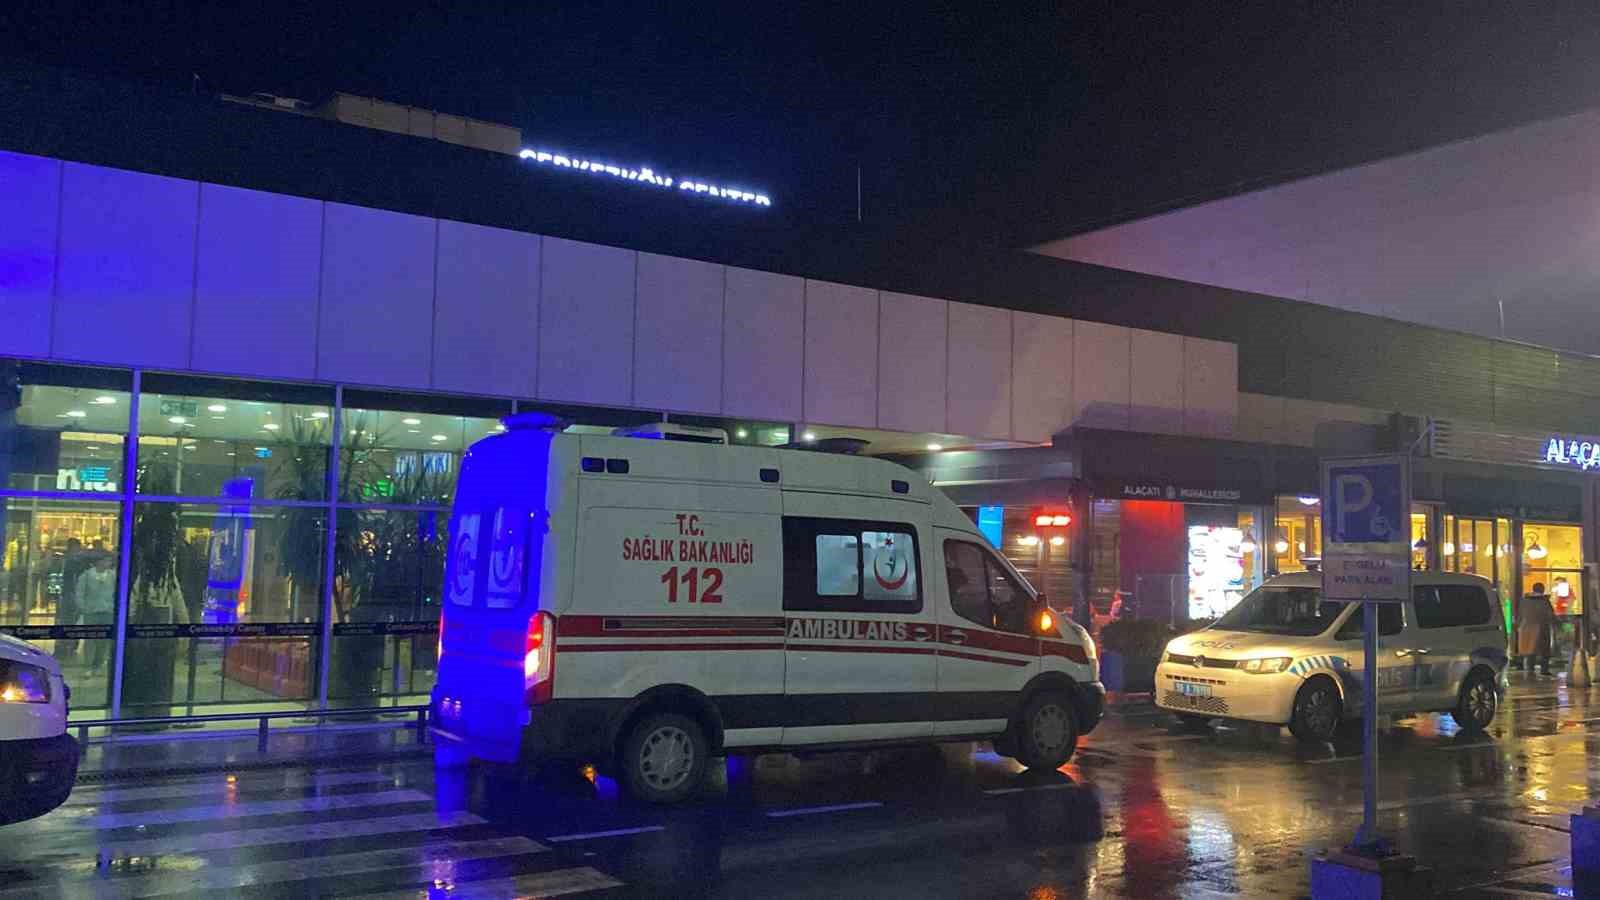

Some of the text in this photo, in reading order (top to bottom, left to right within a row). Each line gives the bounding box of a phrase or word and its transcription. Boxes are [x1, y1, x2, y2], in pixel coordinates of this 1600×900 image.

[1336, 474, 1374, 543] P
[675, 513, 704, 537] T.C.
[623, 534, 754, 564] SAĞLIK BAKANLIĞI
[661, 566, 724, 604] 112
[788, 618, 908, 641] AMBULANS
